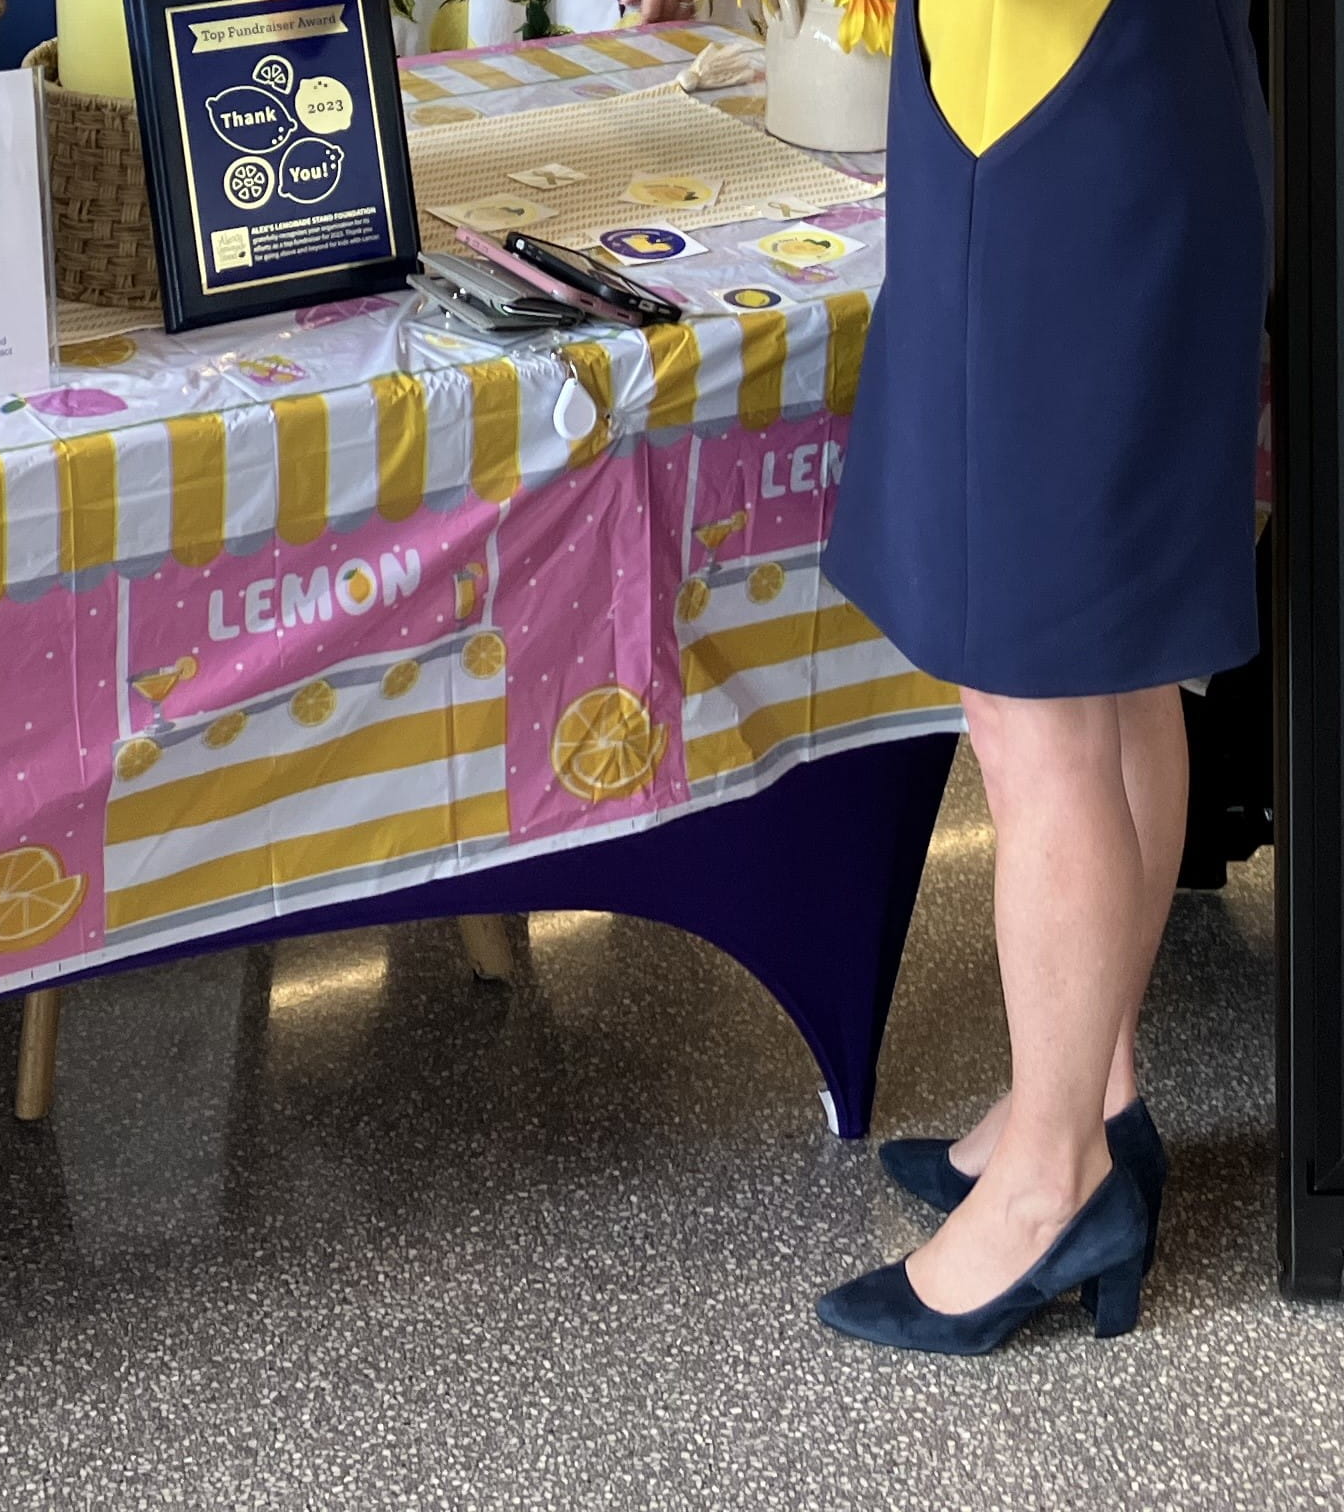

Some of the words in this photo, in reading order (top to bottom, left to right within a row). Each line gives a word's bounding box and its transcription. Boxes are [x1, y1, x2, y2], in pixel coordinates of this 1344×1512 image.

[201, 30, 225, 43] Top
[228, 22, 294, 38] Fundraiser
[297, 14, 336, 29] Award
[220, 106, 277, 130] Thank
[308, 100, 344, 115] 2023
[289, 162, 328, 183] You!
[207, 547, 422, 642] LEMON
